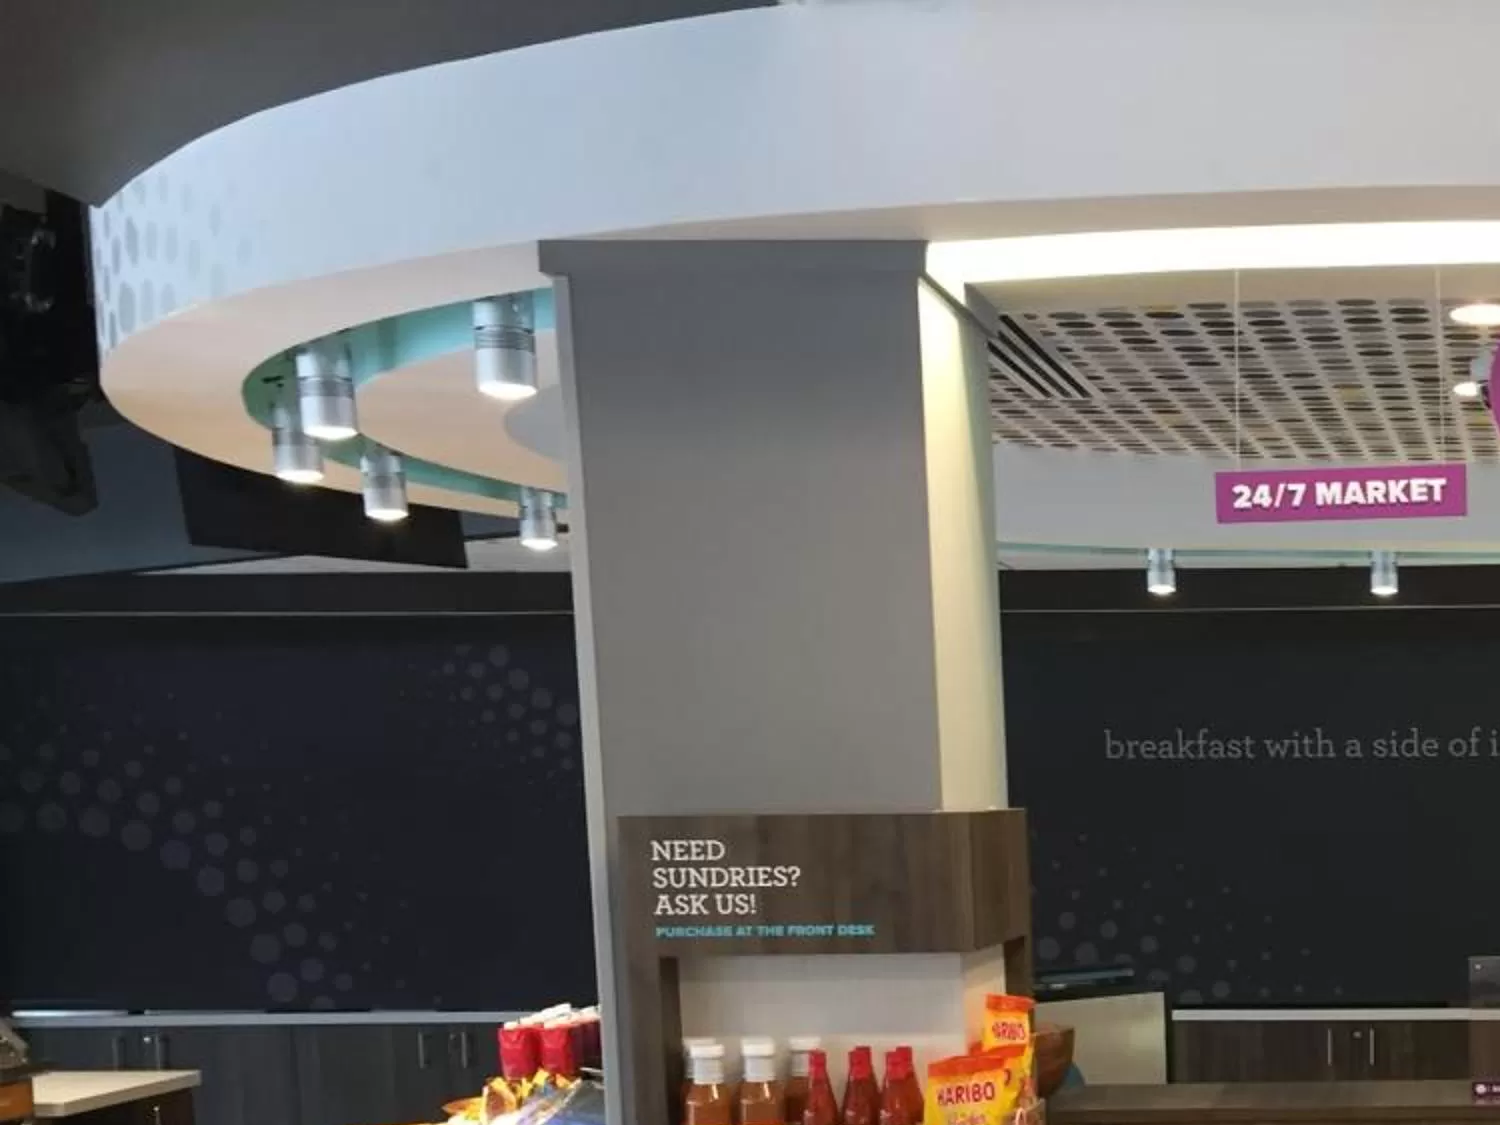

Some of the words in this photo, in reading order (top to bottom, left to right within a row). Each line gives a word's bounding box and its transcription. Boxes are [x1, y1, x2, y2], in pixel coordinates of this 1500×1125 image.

[1232, 483, 1307, 510] 24/7
[1315, 477, 1449, 507] MARKET
[1104, 727, 1256, 760] breakfast
[1264, 727, 1337, 758] with
[1345, 737, 1364, 758] a
[1372, 727, 1439, 758] side
[1448, 726, 1481, 758] of
[650, 840, 726, 861] NEED
[652, 866, 802, 888] SUNDRIES?
[654, 893, 710, 915] ASK
[715, 893, 757, 914] US!
[655, 925, 734, 938] PURCHASE
[736, 925, 753, 937] AT
[757, 925, 785, 937] THE
[787, 925, 834, 937] FRONT
[837, 924, 876, 937] DESK
[936, 1081, 996, 1106] HARIBO
